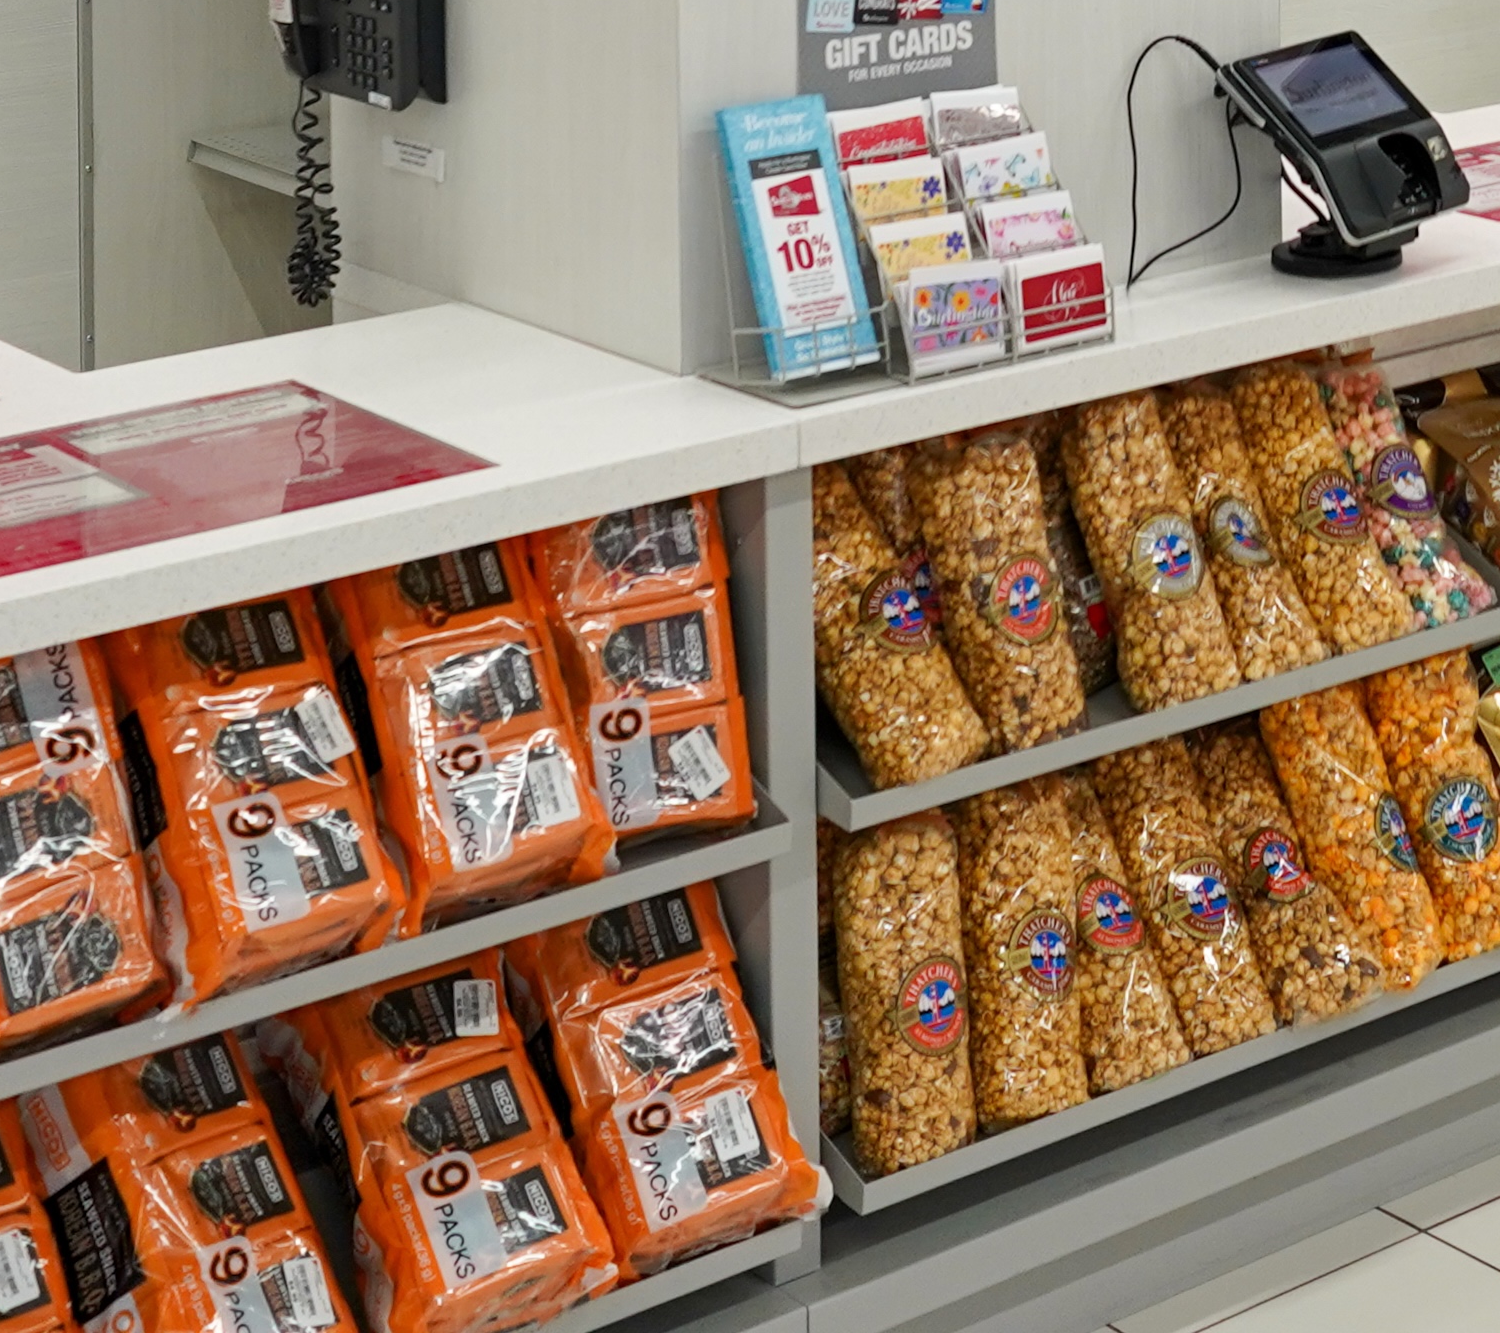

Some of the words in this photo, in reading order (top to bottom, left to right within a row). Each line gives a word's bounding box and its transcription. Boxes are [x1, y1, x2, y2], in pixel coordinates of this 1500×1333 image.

[813, 1, 849, 18] LOVE
[825, 33, 882, 70] GIFT
[888, 21, 973, 61] CARDS
[848, 68, 868, 83] FOR
[870, 64, 900, 80] EVERY
[903, 55, 953, 74] OCCASION
[787, 221, 810, 236] GET
[777, 233, 831, 273] 10%
[600, 707, 643, 742] 9
[604, 748, 631, 826] PACKS
[239, 844, 279, 922] PACKS
[493, 1082, 517, 1124] NICOS
[627, 1102, 672, 1137] 9
[421, 1160, 470, 1199] 9
[640, 1142, 678, 1221] PACKS
[434, 1204, 476, 1279] PACKS
[209, 1246, 249, 1287] 9
